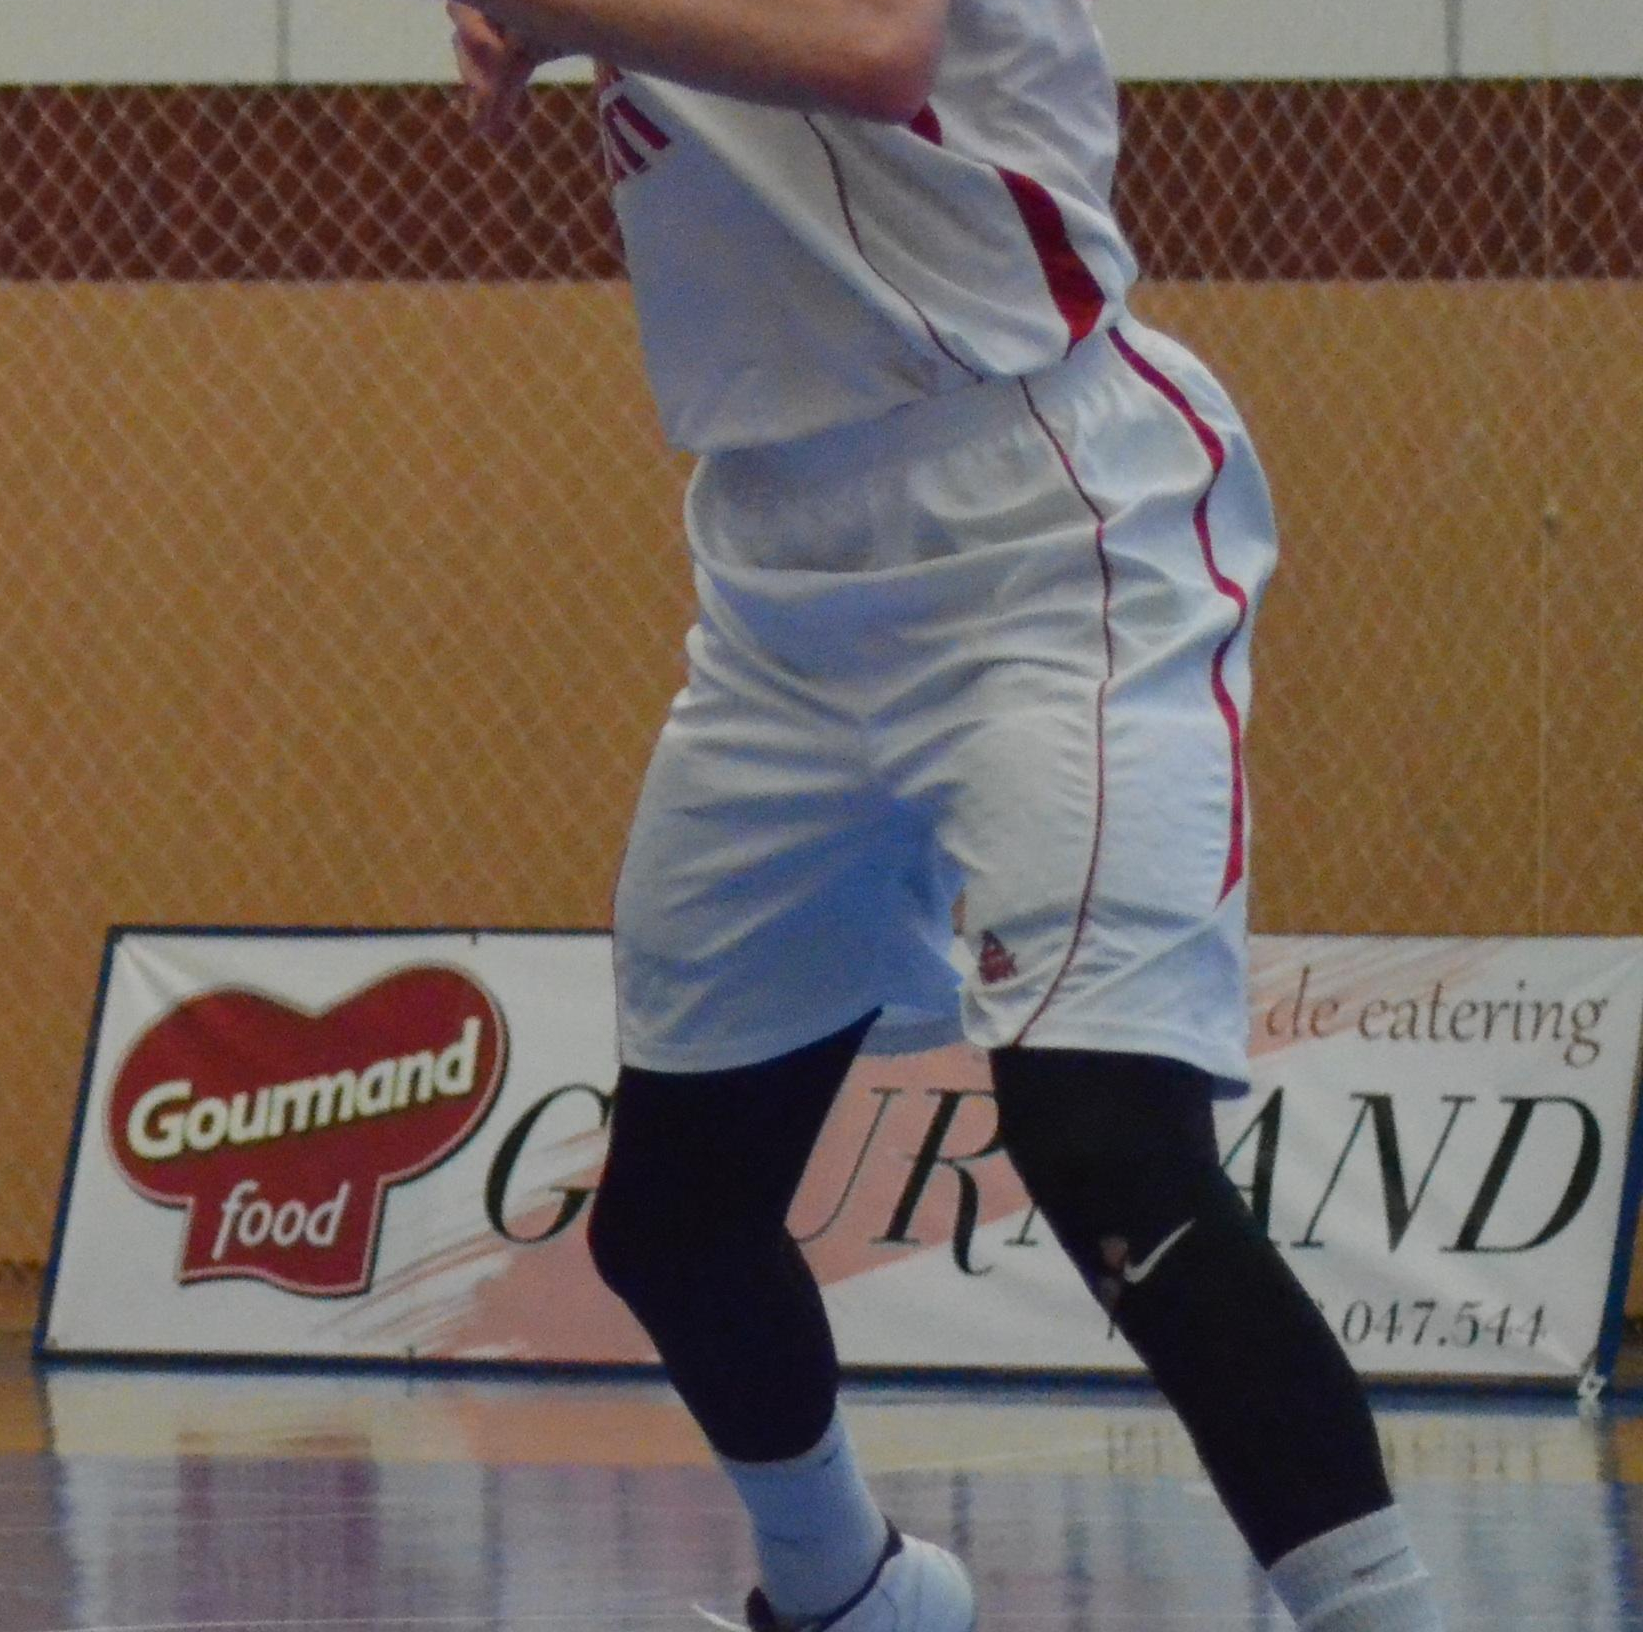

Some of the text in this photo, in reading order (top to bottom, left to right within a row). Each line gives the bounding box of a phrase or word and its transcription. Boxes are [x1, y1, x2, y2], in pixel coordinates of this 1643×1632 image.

[1265, 965, 1608, 1069] de catering
[127, 1015, 482, 1160] Gourmand
[211, 1178, 351, 1261] food
